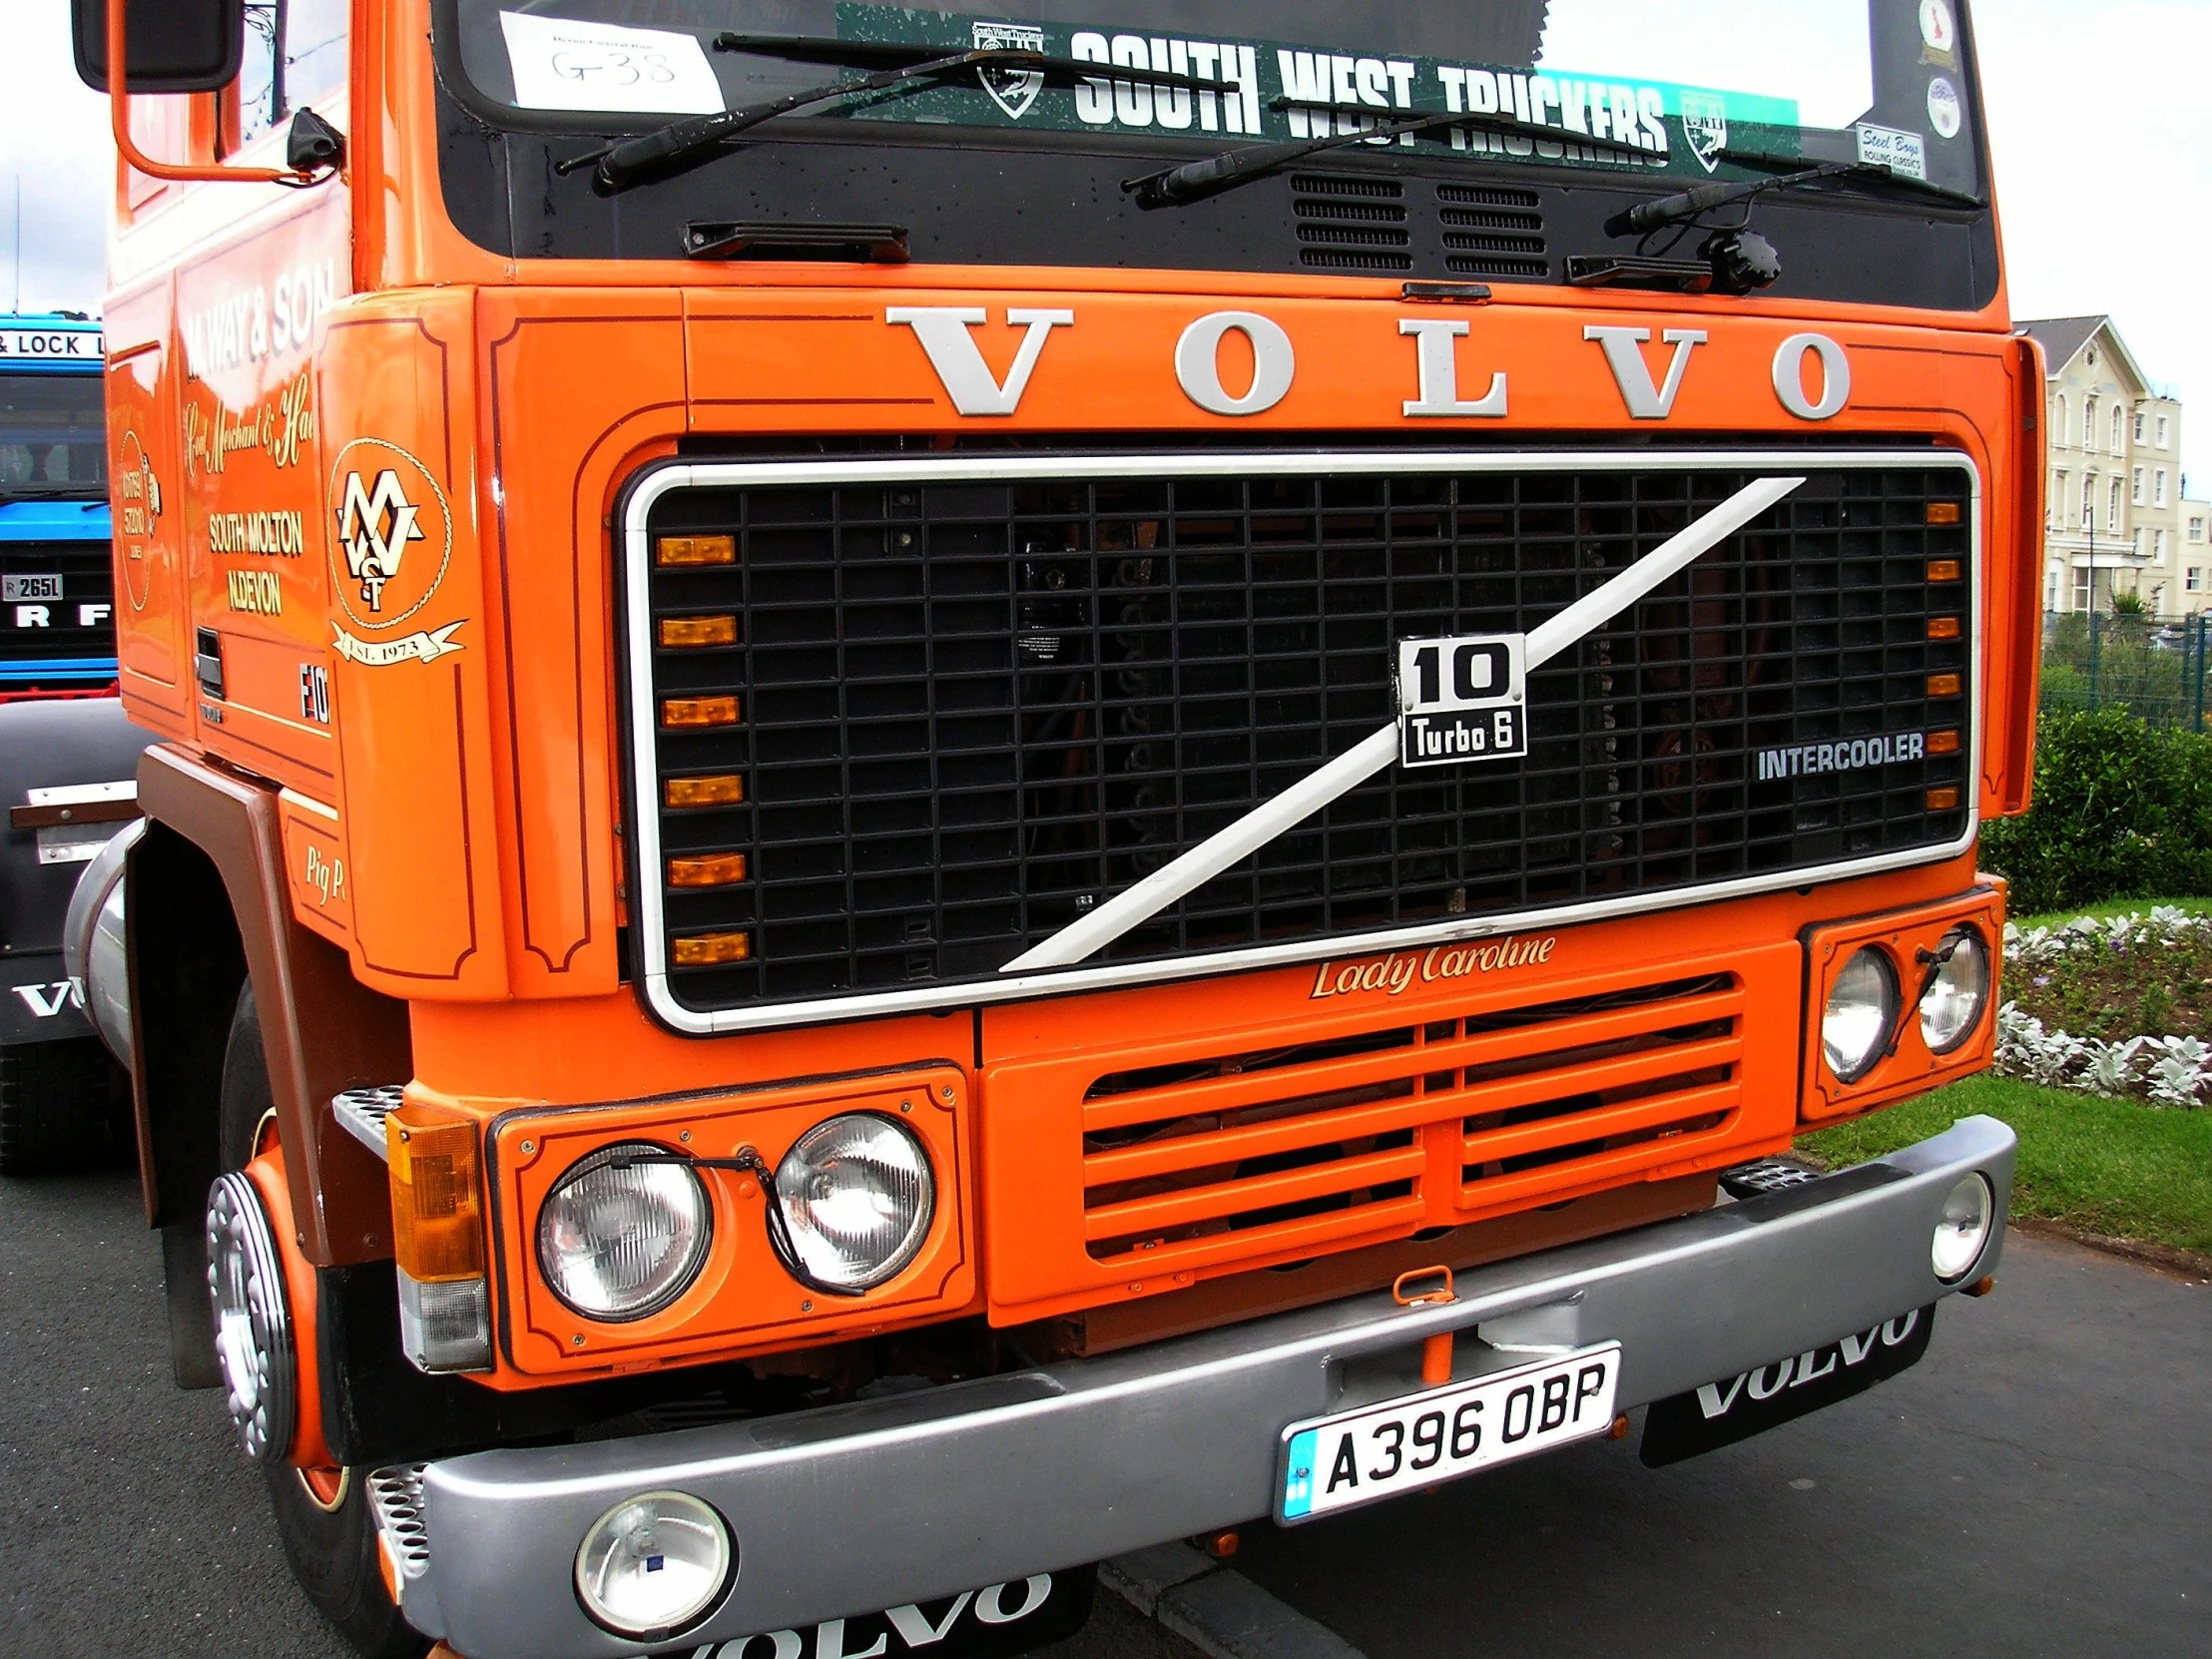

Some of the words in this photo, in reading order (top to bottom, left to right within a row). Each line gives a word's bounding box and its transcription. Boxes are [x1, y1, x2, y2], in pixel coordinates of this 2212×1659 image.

[1070, 32, 1262, 135] SOUTH
[1277, 49, 1414, 148] WEST
[1437, 66, 1669, 168] TRUCKERS
[1863, 130, 1891, 149] Steel
[19, 335, 80, 354] LOCK
[884, 306, 1852, 419] VOLVO
[209, 512, 246, 553] SOUTH
[247, 510, 303, 556] MOLTON
[20, 578, 59, 598] 265L
[382, 641, 419, 661] 1973
[1413, 642, 1511, 705] 10
[1411, 717, 1485, 757] Turbo
[1493, 710, 1513, 749] 6
[1759, 732, 1924, 781] INTERCOOLER
[306, 844, 329, 906] Pig
[1310, 952, 1417, 999] Lady
[1421, 935, 1556, 982] Caroline
[1697, 1309, 1920, 1419] VOLVO
[1326, 1399, 1484, 1494] A396
[1501, 1363, 1606, 1445] OBP
